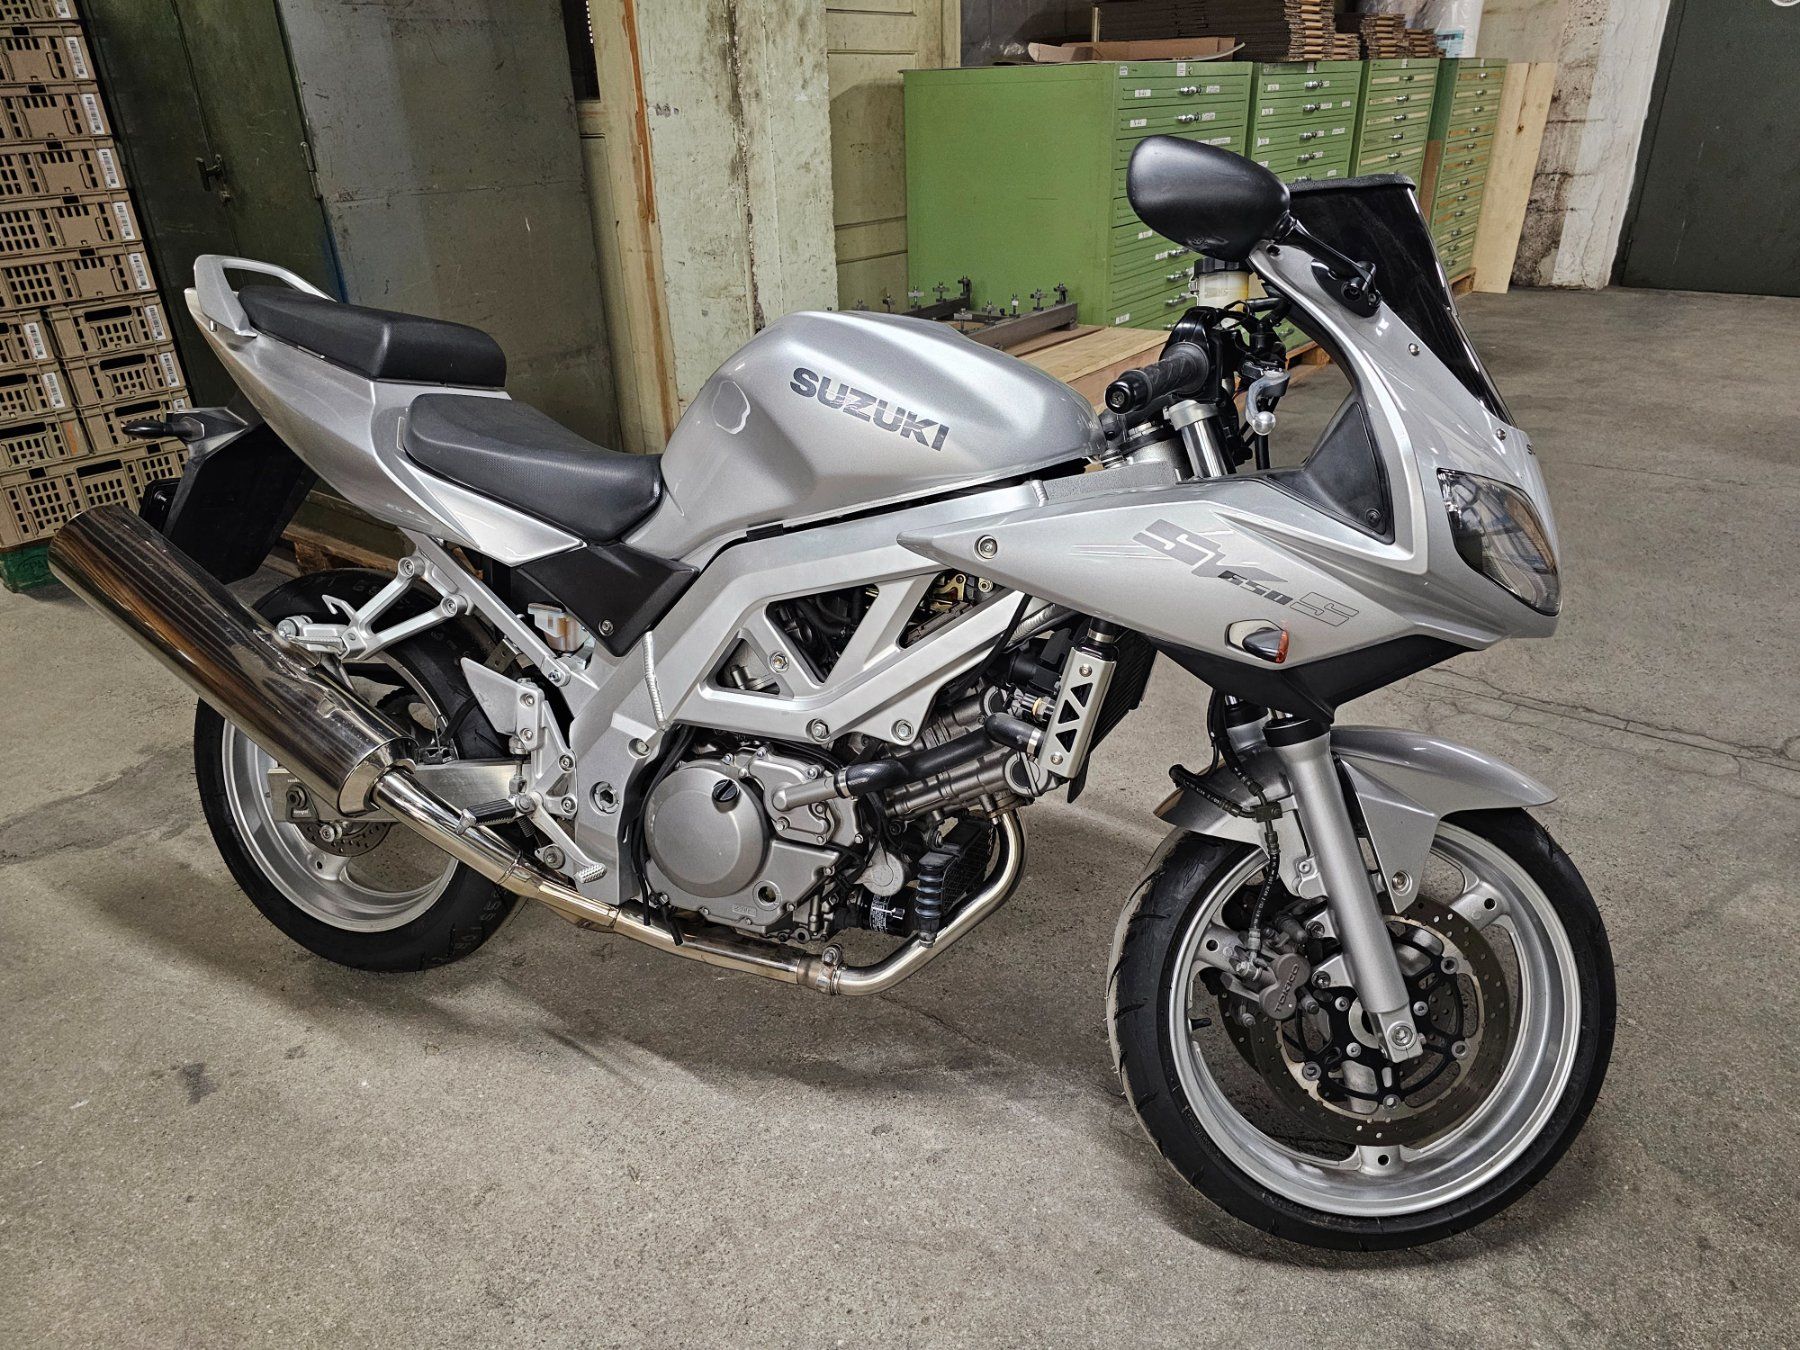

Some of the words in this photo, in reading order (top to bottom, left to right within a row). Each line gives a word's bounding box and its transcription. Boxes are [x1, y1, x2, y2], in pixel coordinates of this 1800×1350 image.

[789, 367, 950, 451] SUZUKI
[1217, 570, 1294, 605] 650
[1290, 591, 1359, 627] S
[1274, 963, 1300, 1013] TOKICO
